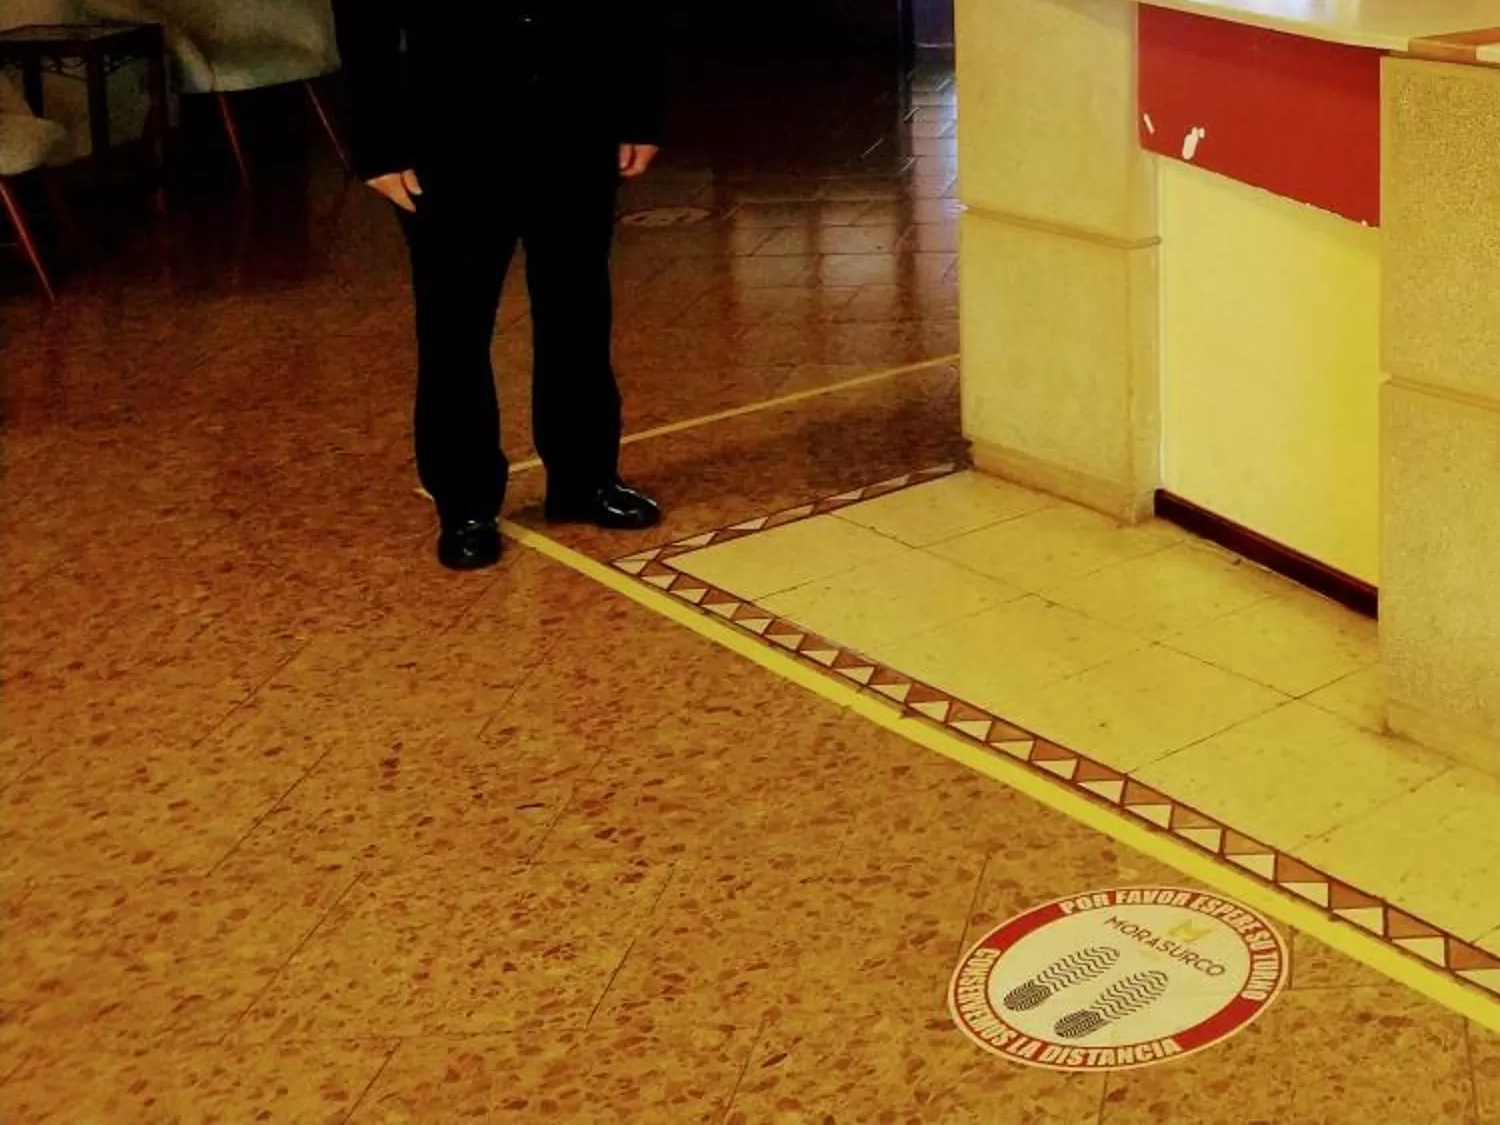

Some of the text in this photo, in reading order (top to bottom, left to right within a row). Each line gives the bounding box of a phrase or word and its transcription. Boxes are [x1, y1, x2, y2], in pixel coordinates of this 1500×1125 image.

[1059, 889, 1280, 1002] POR FAVOR ESPERE SU TURNO
[1104, 915, 1227, 977] MORASURCO
[957, 947, 1184, 1067] CONSERVEMOS LA DISTANCIA
